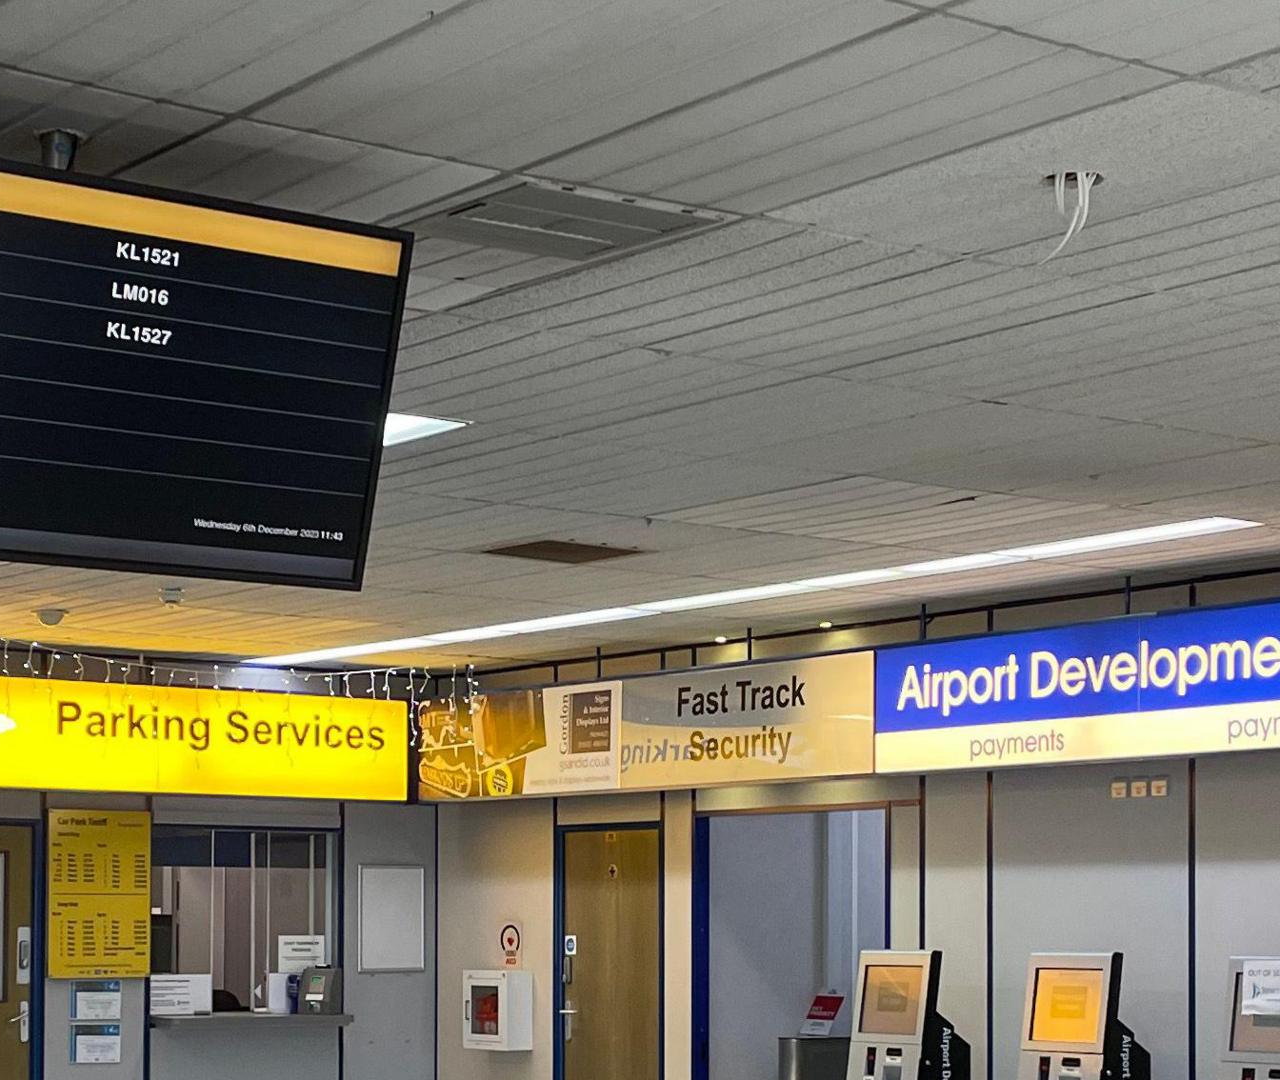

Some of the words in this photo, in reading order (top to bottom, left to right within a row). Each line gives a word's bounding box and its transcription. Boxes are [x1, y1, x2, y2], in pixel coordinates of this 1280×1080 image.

[116, 241, 180, 267] KL1521
[112, 282, 169, 305] LM016
[106, 321, 172, 345] KL1527
[193, 518, 241, 533] Wednesday
[242, 523, 256, 532] 6th
[257, 525, 298, 537] December
[320, 530, 344, 541] 11:43
[677, 684, 729, 717] Fast
[736, 675, 806, 712] Track
[896, 653, 1020, 717] Airport
[57, 701, 210, 751] Parking
[226, 710, 385, 751] Services
[560, 694, 569, 755] Gordon
[690, 725, 792, 764] Security
[970, 729, 1065, 762] payments
[1248, 969, 1261, 977] OUT
[940, 1027, 952, 1068] Airport
[1120, 1034, 1131, 1078] Airport
